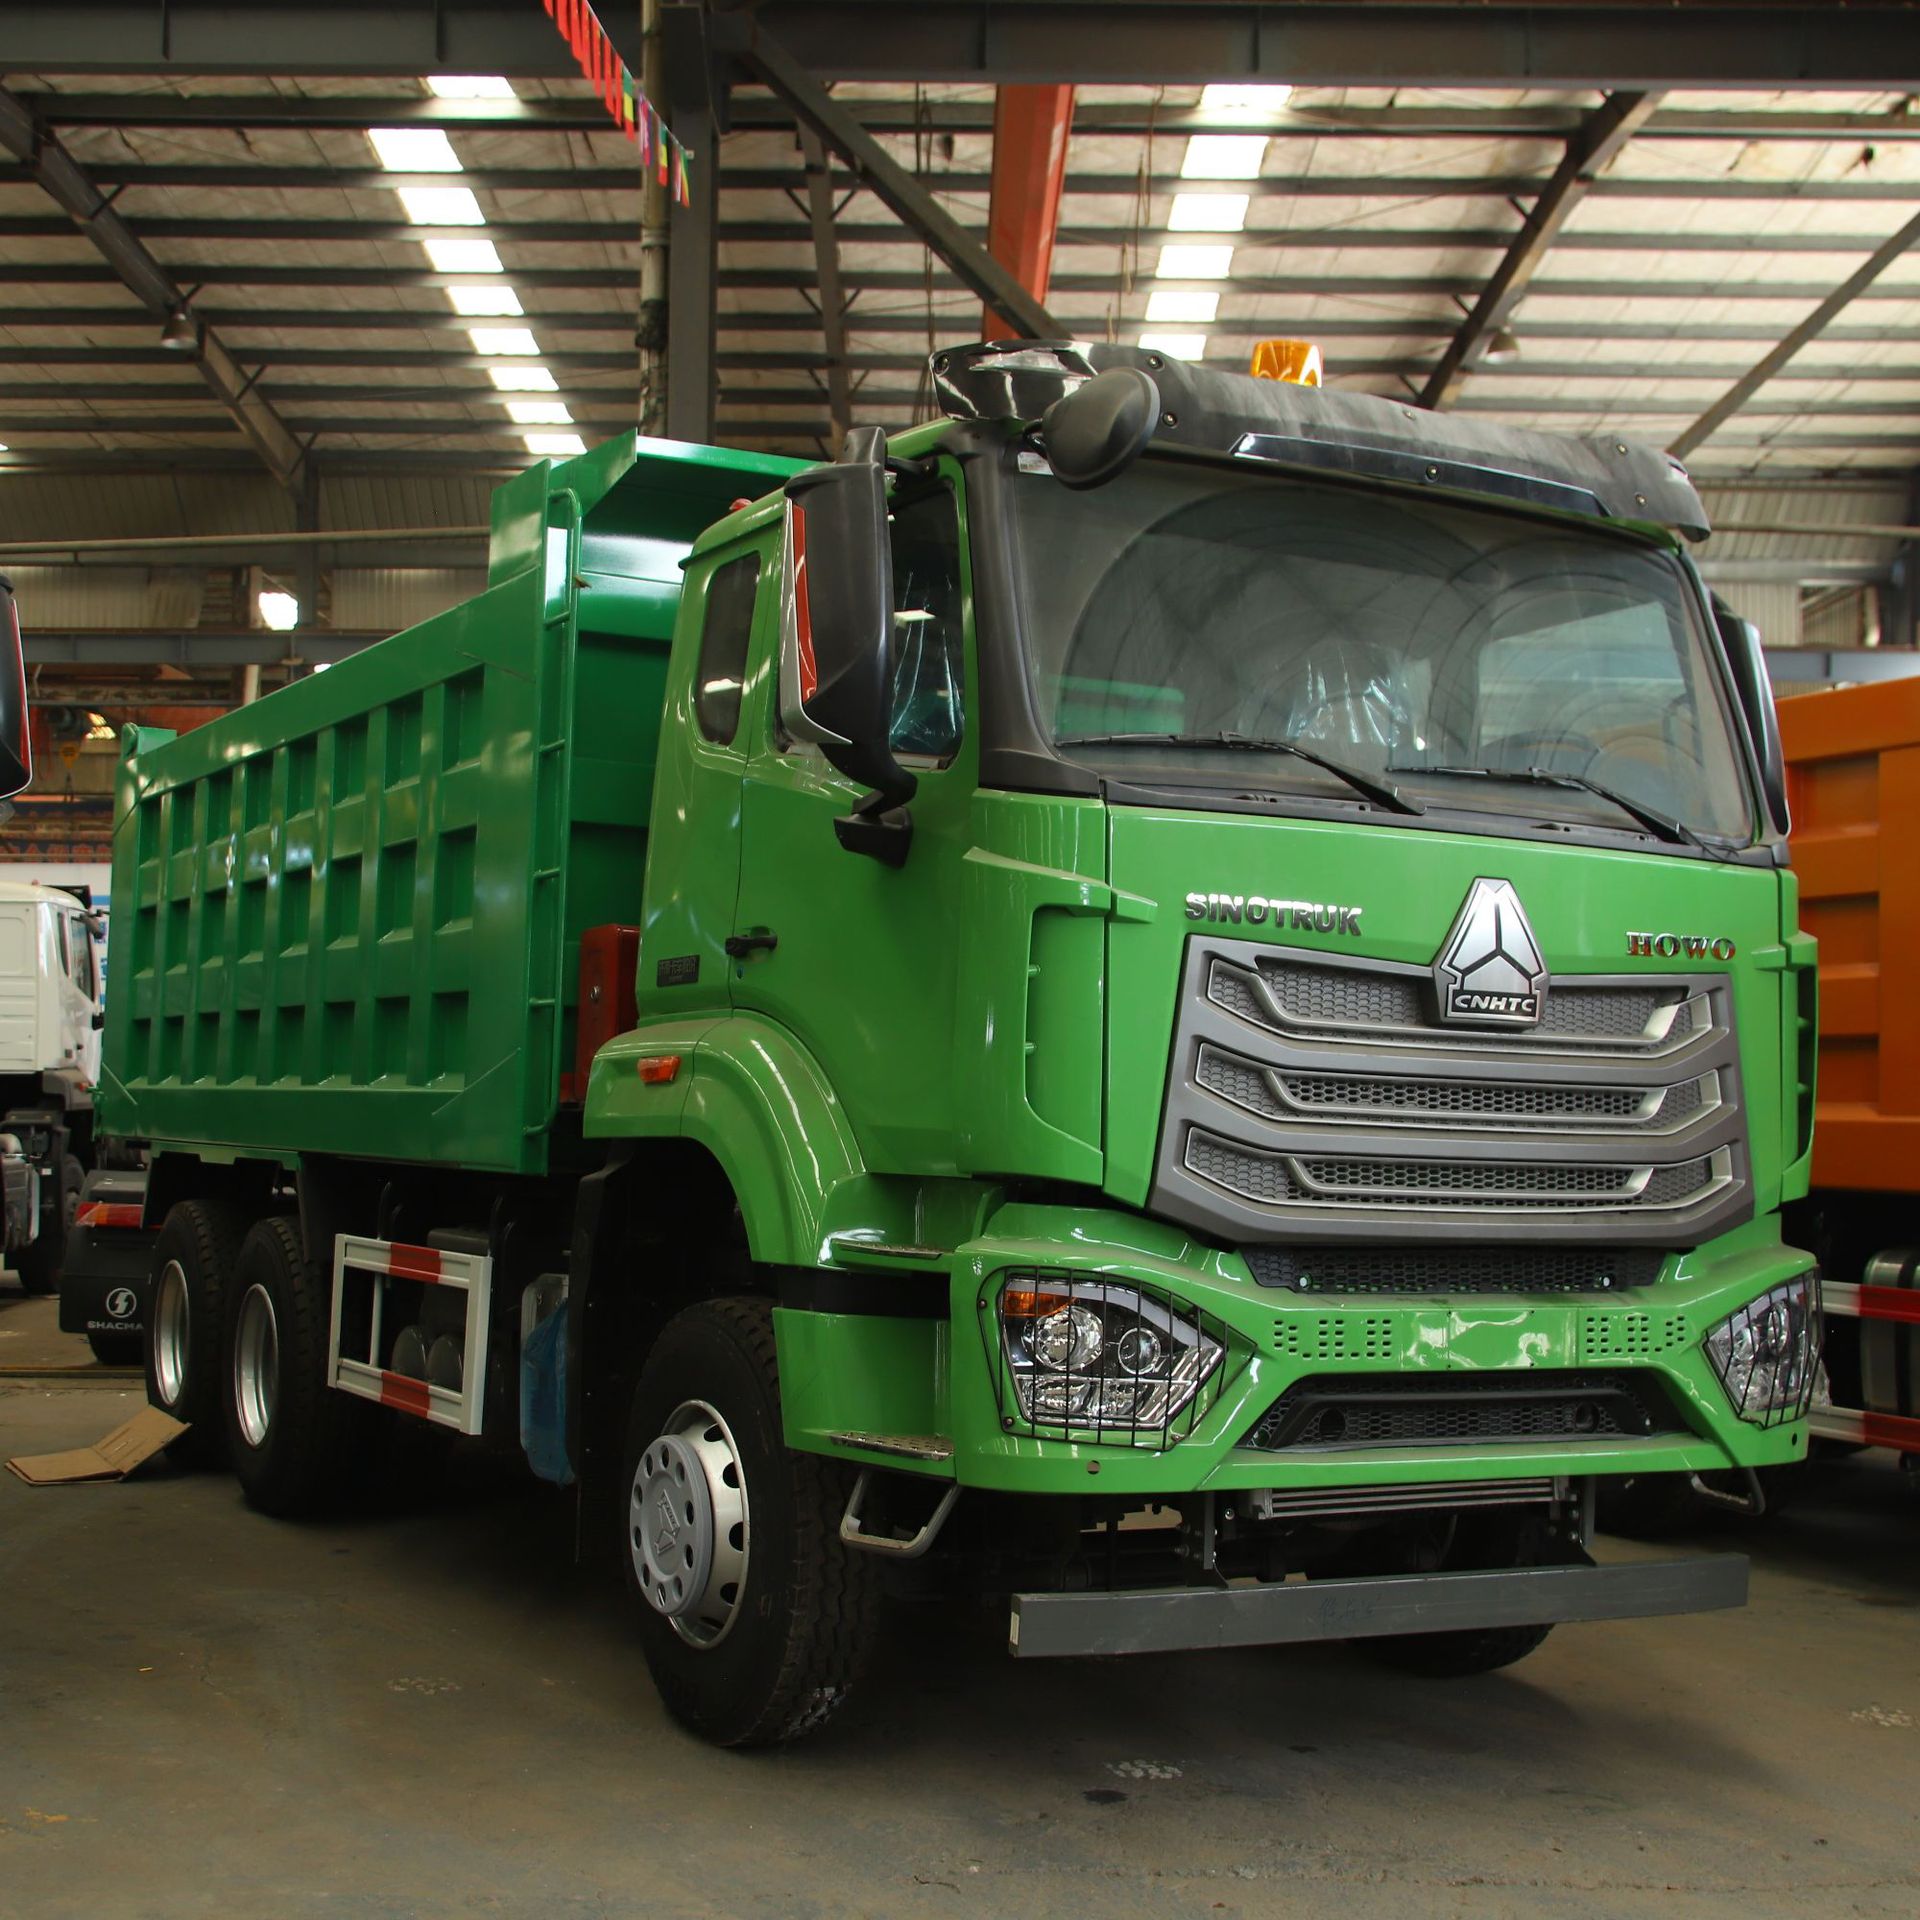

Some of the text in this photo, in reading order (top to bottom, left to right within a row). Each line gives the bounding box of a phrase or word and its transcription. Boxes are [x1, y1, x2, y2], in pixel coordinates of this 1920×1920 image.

[1185, 892, 1363, 936] SINOTRUK
[1625, 931, 1736, 960] HOWO
[1455, 994, 1535, 1012] CNHTC
[87, 1320, 145, 1330] SHACMA
